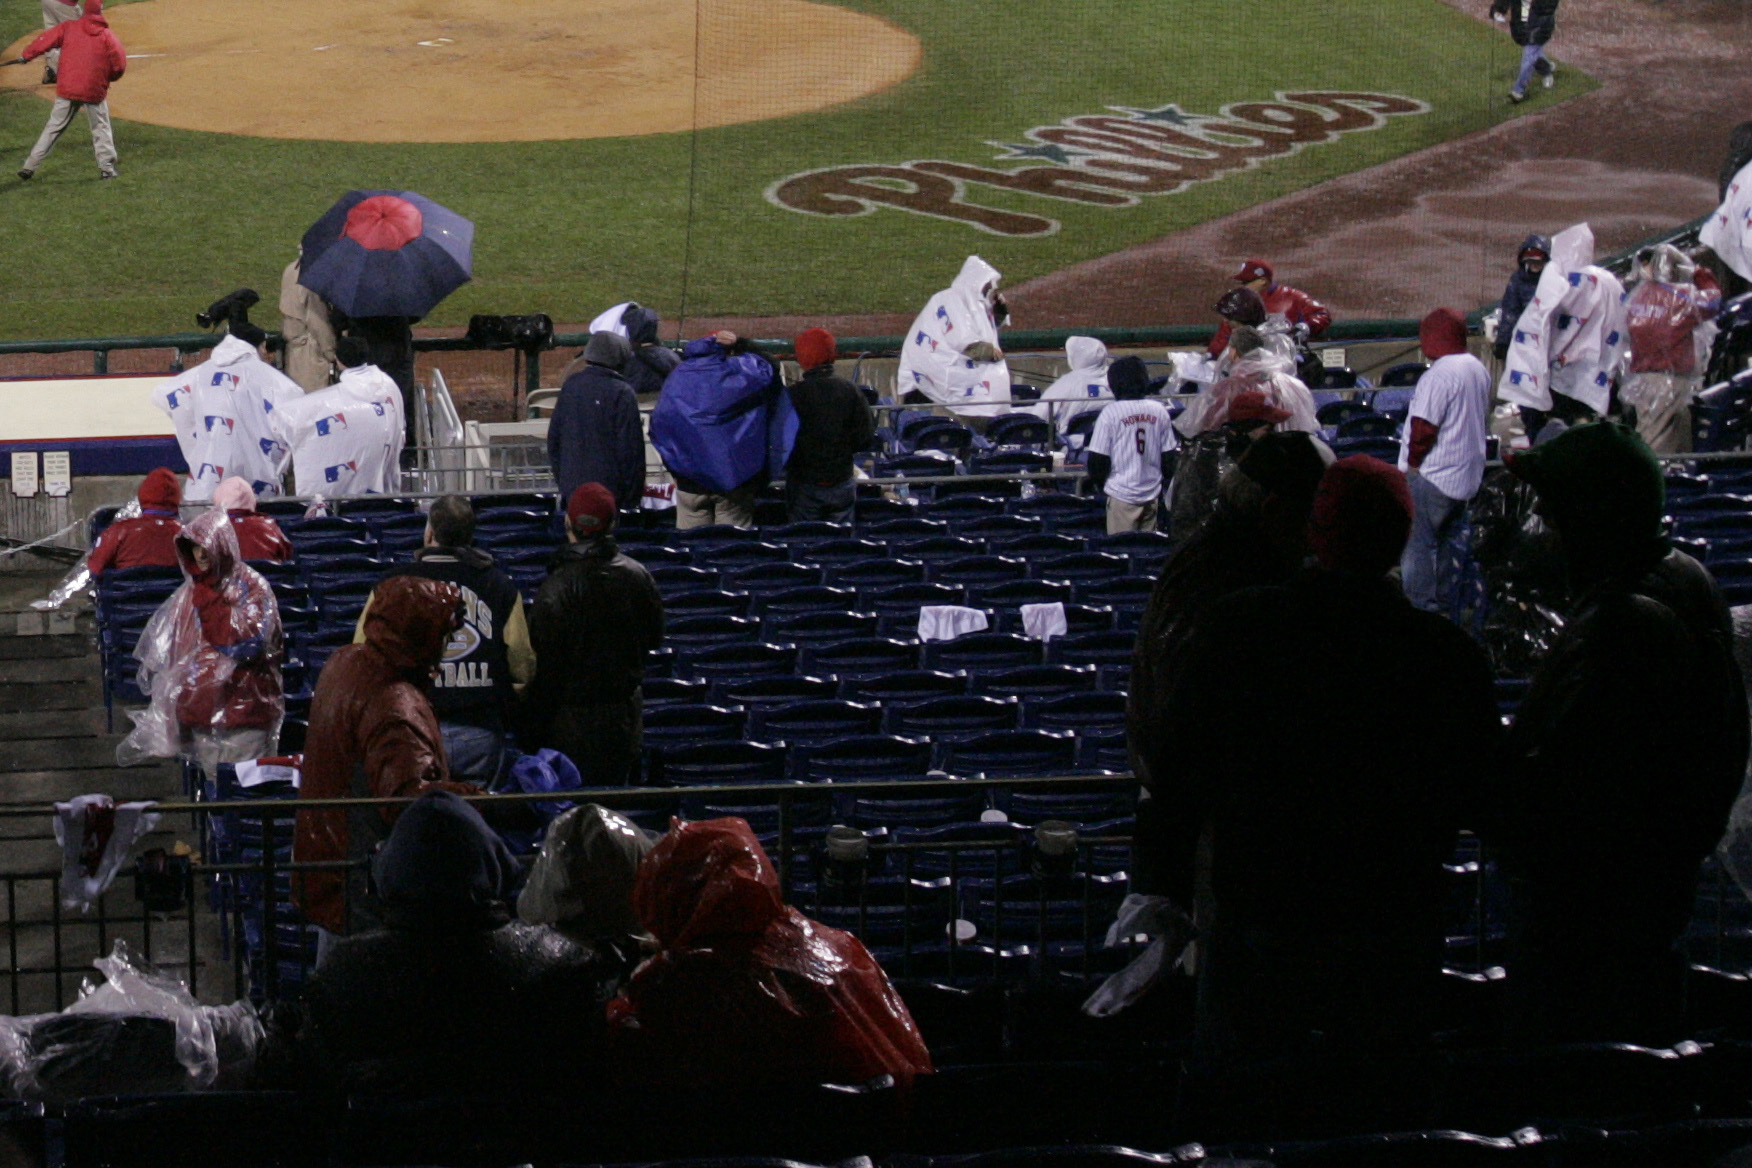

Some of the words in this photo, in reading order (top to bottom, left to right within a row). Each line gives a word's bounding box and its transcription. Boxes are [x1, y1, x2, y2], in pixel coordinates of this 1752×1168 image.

[764, 90, 1432, 237] Phillies
[1121, 413, 1157, 427] HOWARD
[1135, 428, 1145, 456] 6
